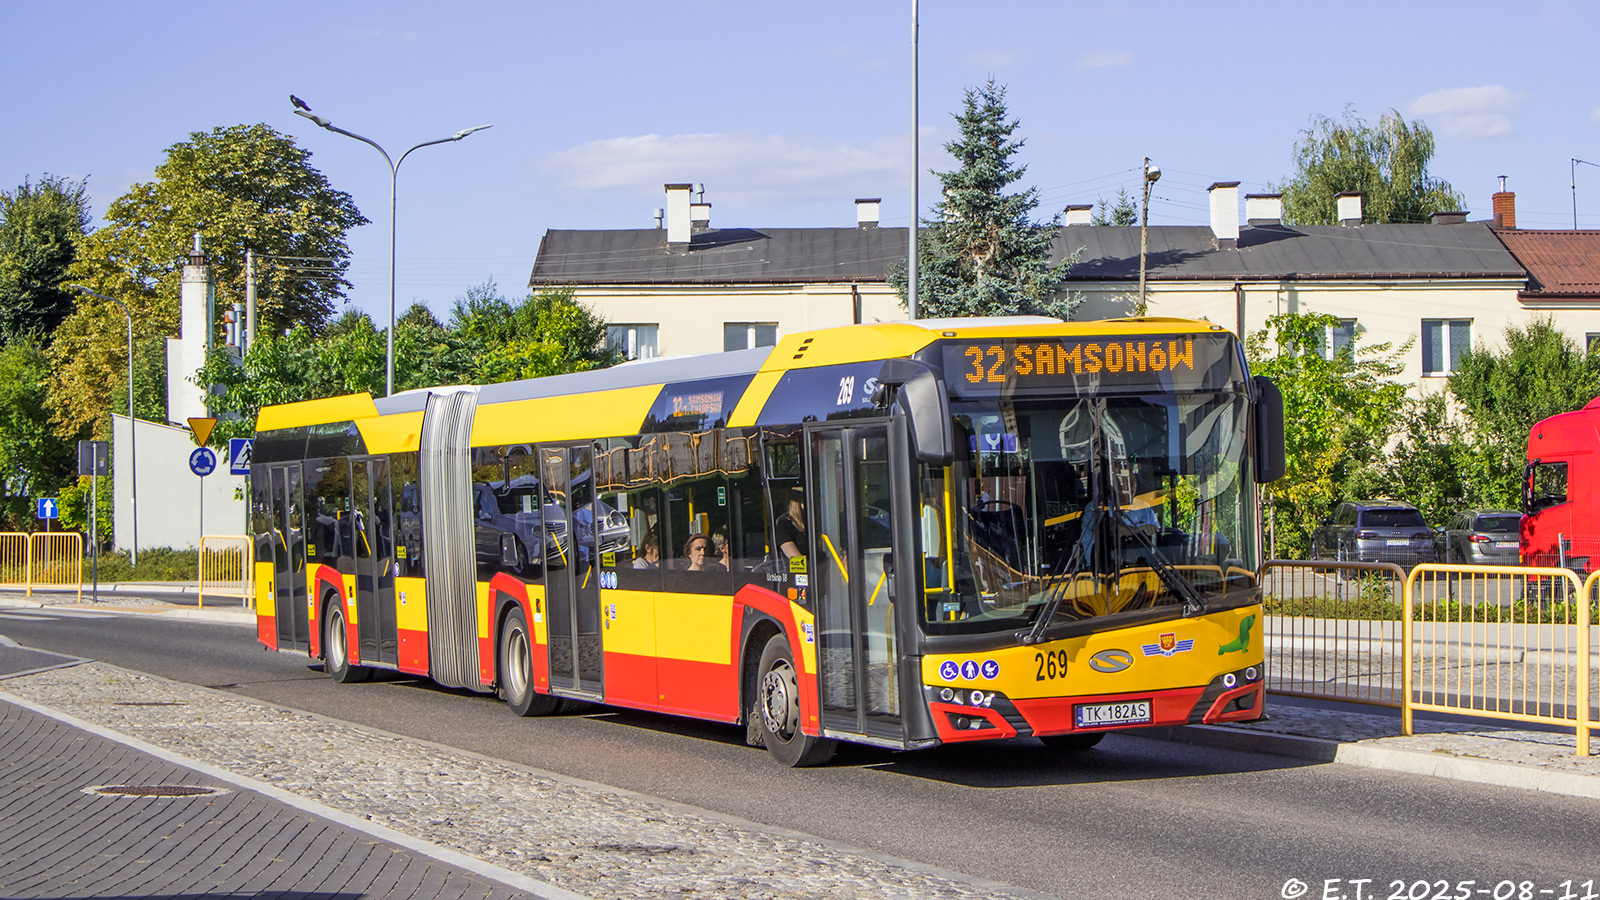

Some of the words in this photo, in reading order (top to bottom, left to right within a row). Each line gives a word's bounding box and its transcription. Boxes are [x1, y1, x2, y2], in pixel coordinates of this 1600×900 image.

[964, 345, 1006, 383] 32
[837, 375, 855, 405] 269
[672, 396, 683, 417] 32
[766, 573, 782, 582] Urbino
[782, 573, 788, 582] 18
[1035, 649, 1069, 681] 269
[1085, 705, 1101, 721] TK
[1107, 703, 1146, 719] 182AS
